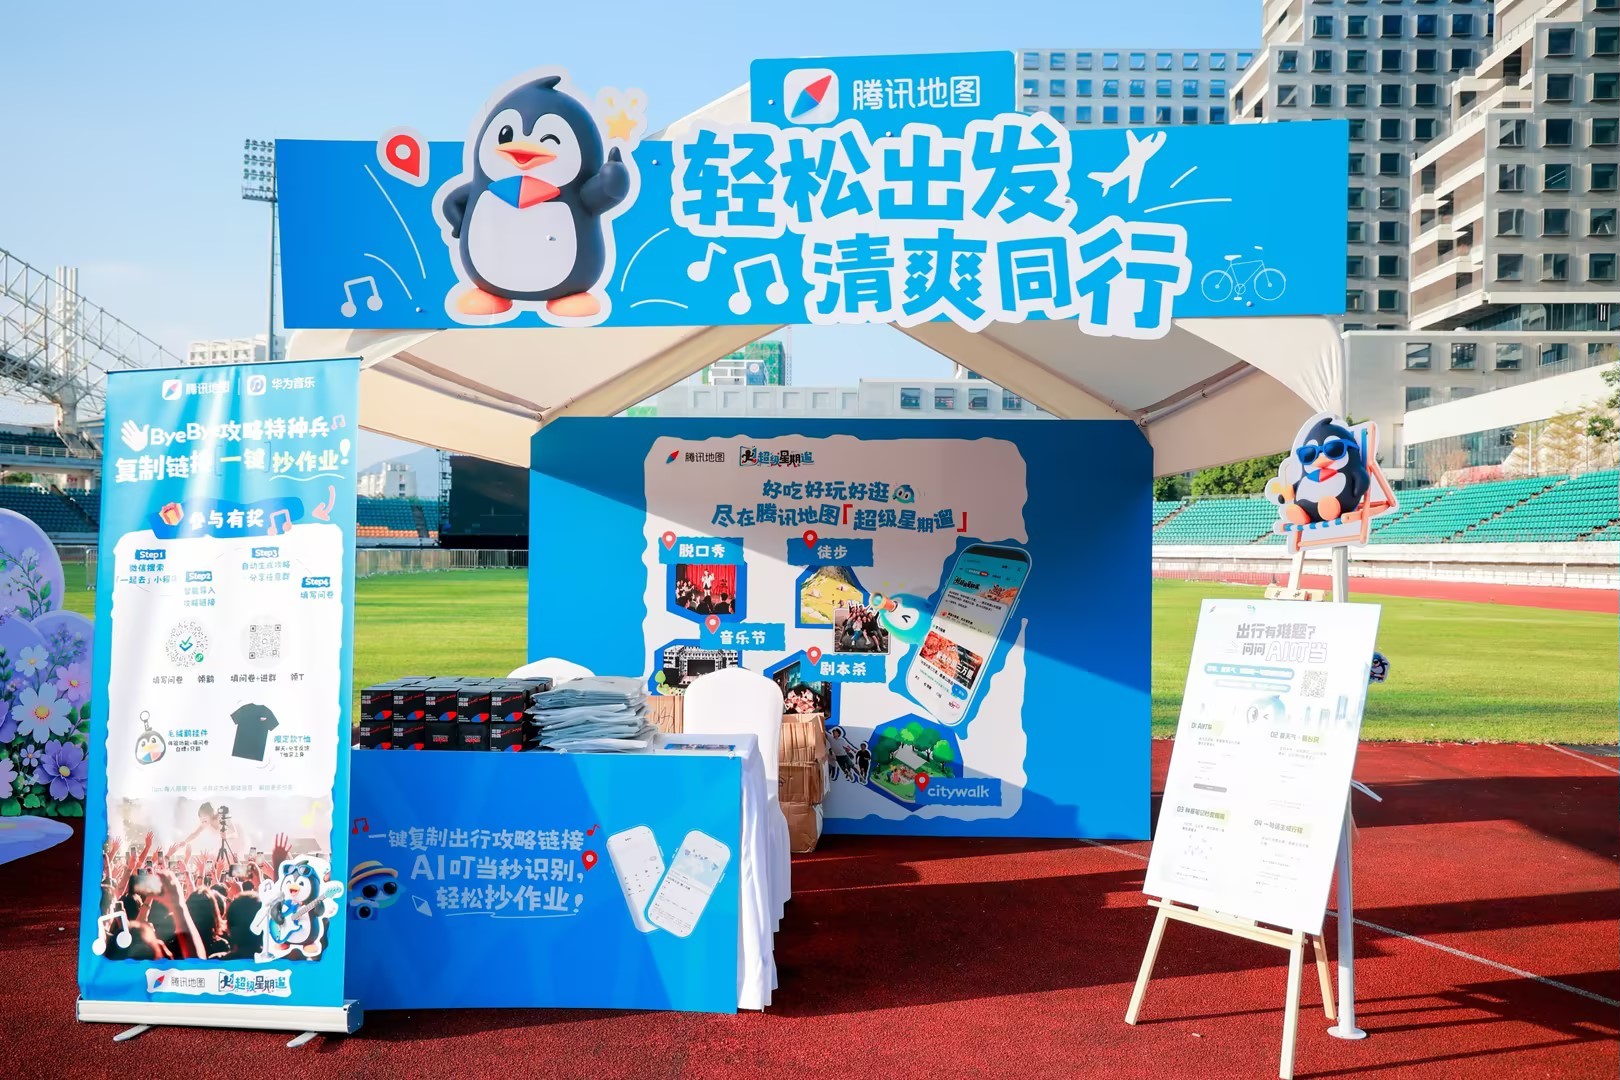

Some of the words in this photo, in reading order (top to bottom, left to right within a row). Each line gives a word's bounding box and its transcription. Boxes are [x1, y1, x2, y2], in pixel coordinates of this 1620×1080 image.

[851, 76, 980, 110] 腾讯地图
[681, 123, 1070, 226] 轻松出发
[811, 229, 1182, 328] 清爽同行
[186, 381, 230, 395] 腾讯地图
[272, 377, 315, 390] 华为音乐
[685, 452, 725, 464] 腾讯地图
[762, 480, 890, 503] 好吃好玩好逛
[189, 508, 264, 530] 参与有奖
[139, 551, 164, 560] Step1
[255, 549, 278, 558] Step3
[678, 544, 726, 559] 脱口秀
[817, 545, 848, 560] 徒步
[129, 563, 164, 572] 微信搜索
[189, 572, 211, 581] Step2
[301, 591, 334, 600] 填写问卷
[719, 631, 766, 646] 音乐节
[819, 662, 867, 677] 剧本杀
[153, 676, 183, 685] 填写问卷
[927, 784, 990, 799] citywalk
[368, 826, 585, 852] 一键复制出行攻略链接
[171, 977, 205, 988] 腾讯地图
